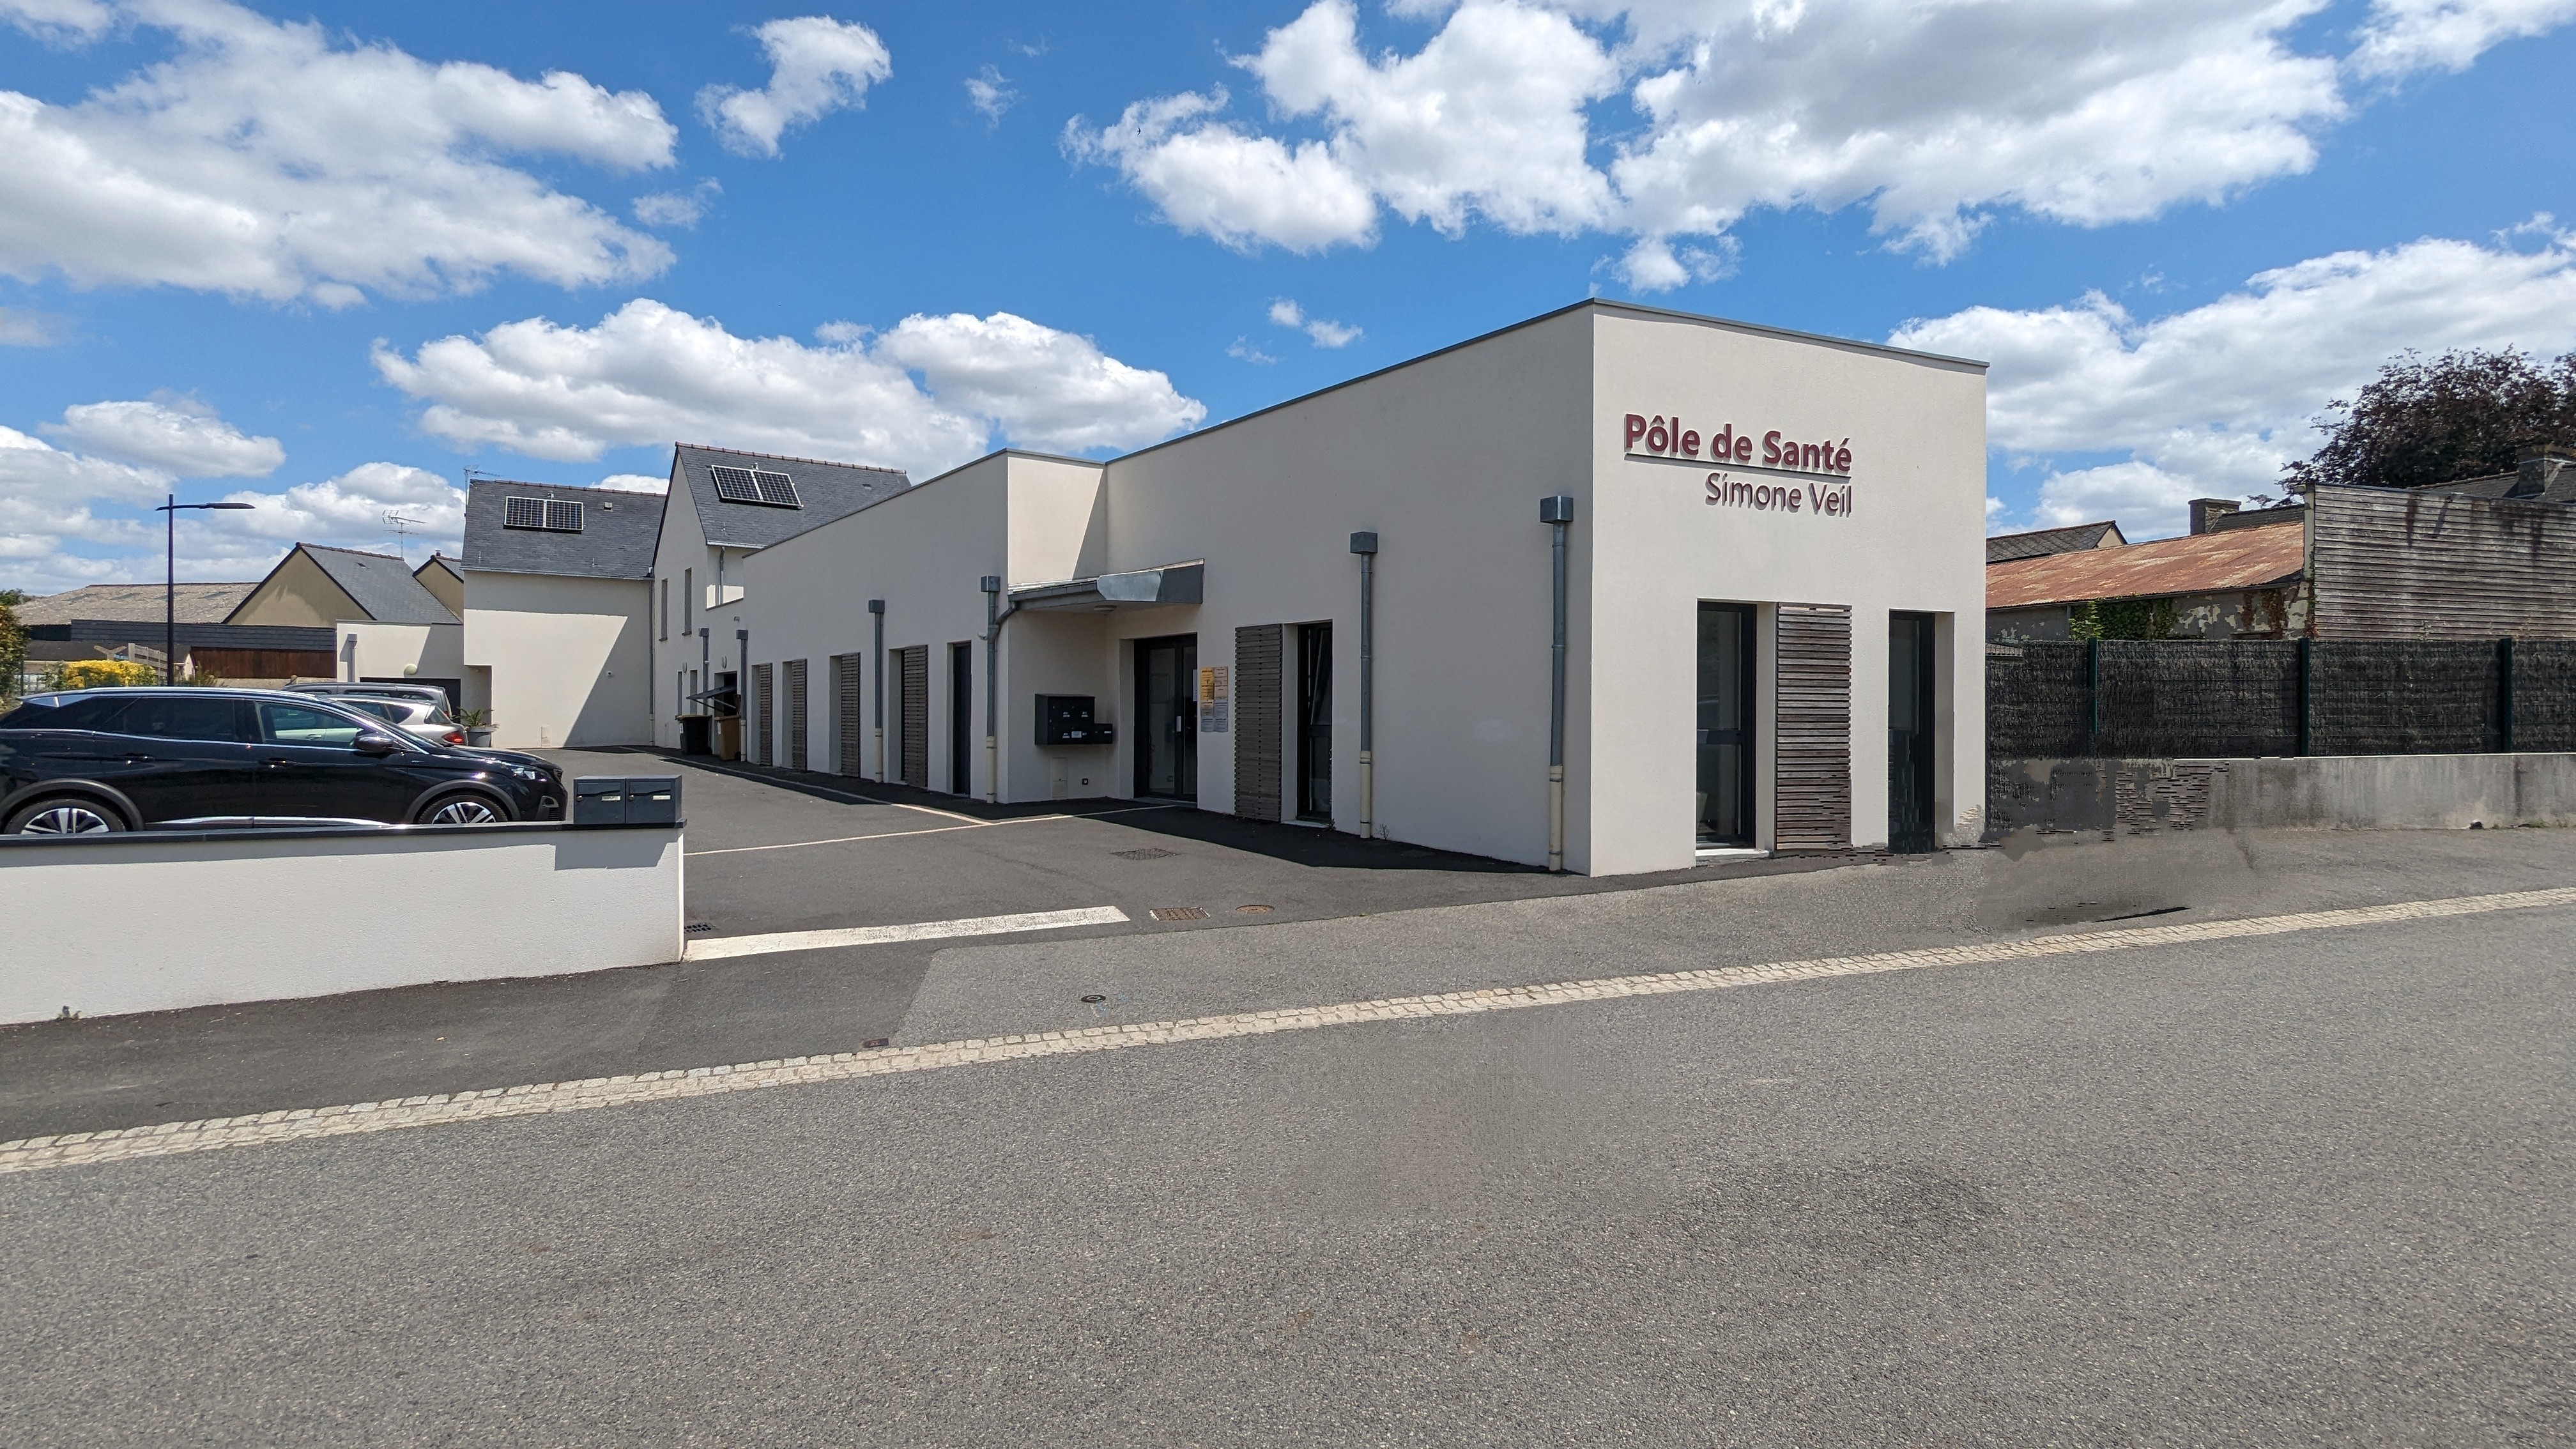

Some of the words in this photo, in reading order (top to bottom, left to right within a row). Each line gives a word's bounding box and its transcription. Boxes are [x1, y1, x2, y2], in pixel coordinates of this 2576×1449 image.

[1625, 413, 1701, 456] Pôle
[1712, 423, 1752, 461] de
[1764, 431, 1852, 472] Santé
[1707, 472, 1802, 509] Simone
[1809, 482, 1851, 513] Veil
